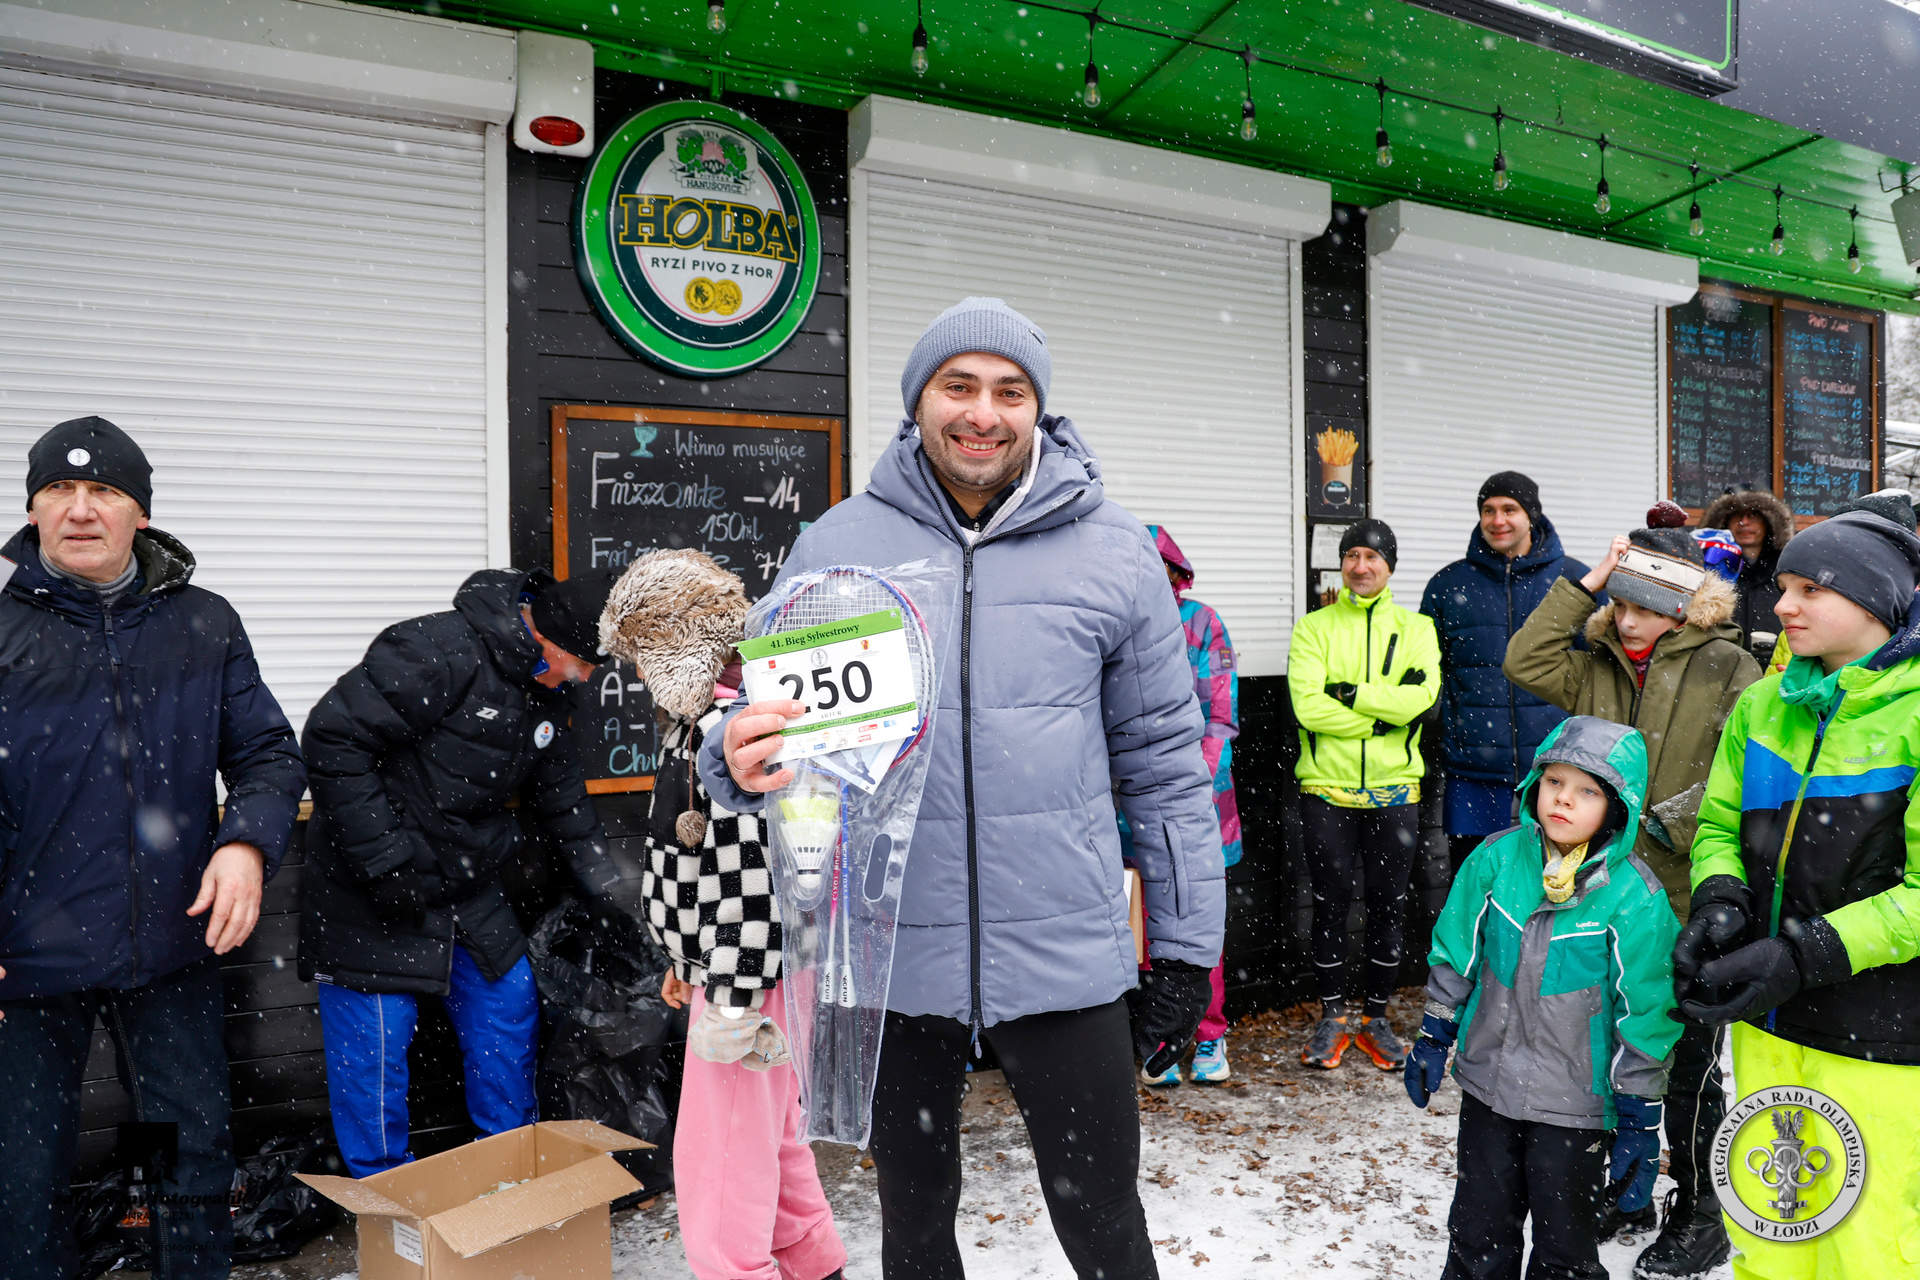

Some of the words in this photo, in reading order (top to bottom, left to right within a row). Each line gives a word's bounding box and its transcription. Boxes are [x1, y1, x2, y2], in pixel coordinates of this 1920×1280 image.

[619, 194, 798, 264] HOLBA
[651, 257, 686, 270] RYZÍ
[692, 260, 726, 273] PIVO
[731, 264, 740, 274] Z
[744, 265, 773, 279] HOR
[674, 429, 725, 457] Winno
[733, 437, 806, 465] musujące
[591, 452, 727, 509] Frizzante
[700, 512, 764, 542] 150ml
[770, 640, 784, 650] 41.
[786, 636, 806, 647] Bieg
[807, 623, 860, 642] Sylwestrowy
[778, 660, 873, 714] 250
